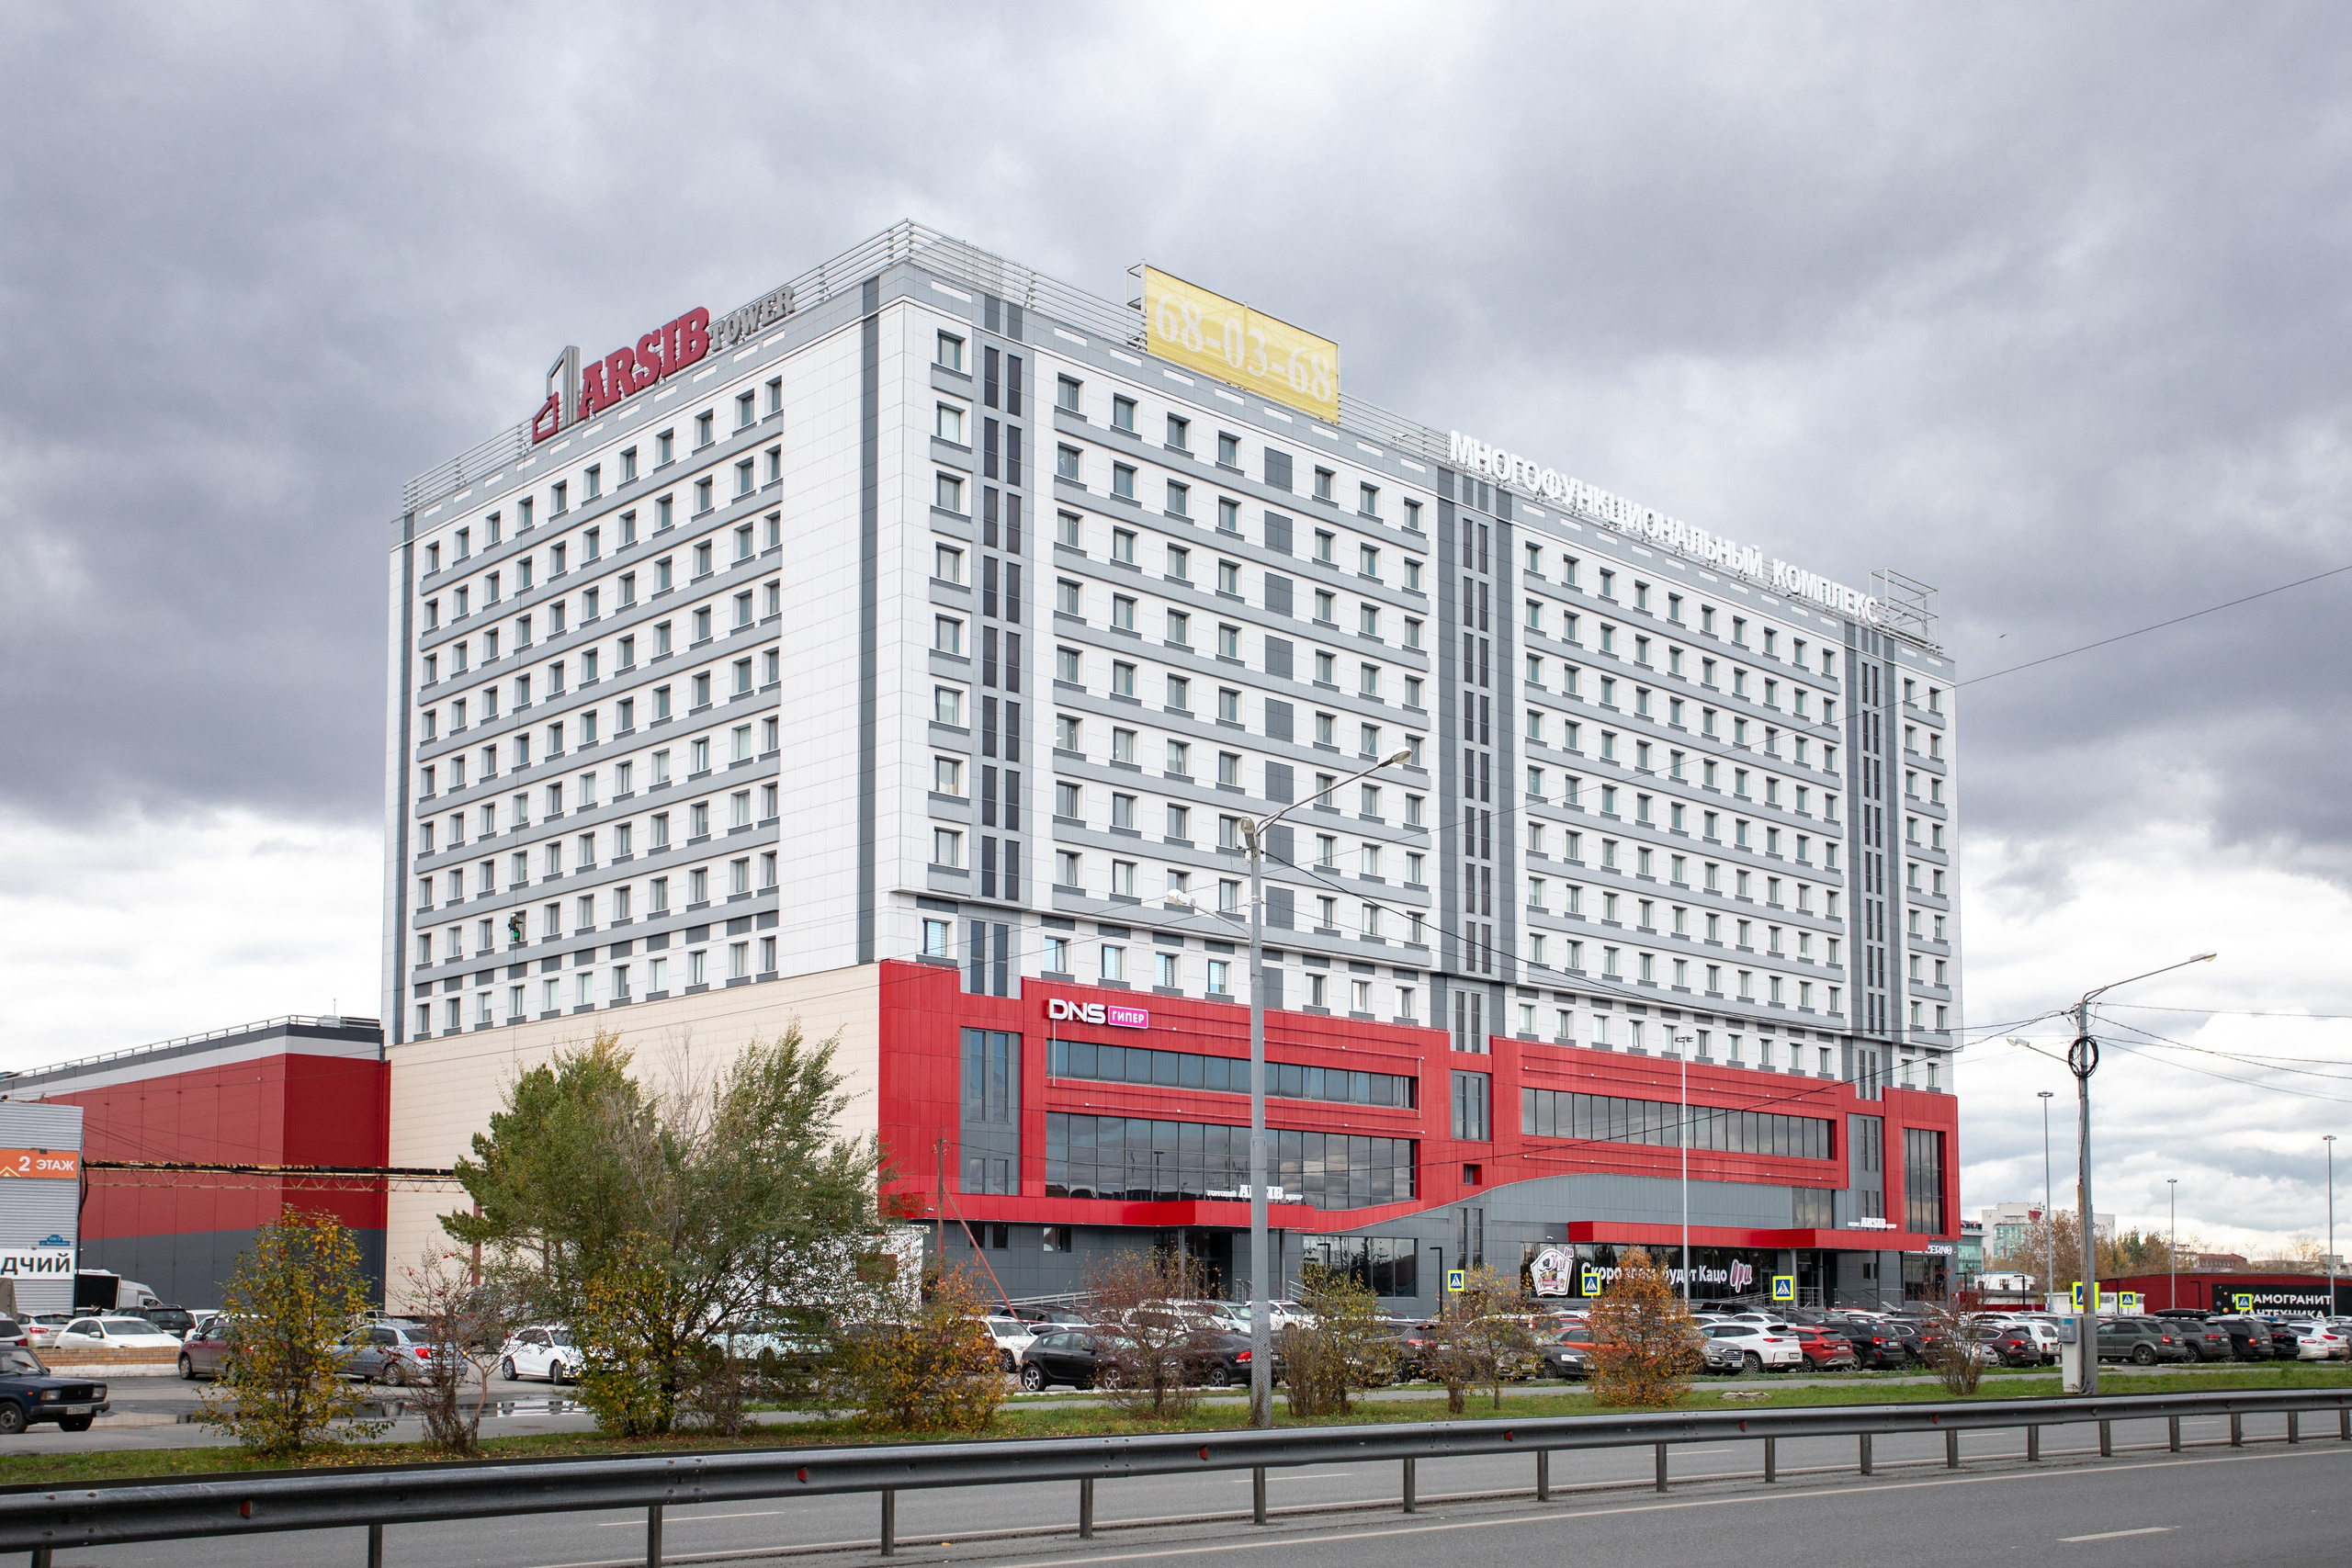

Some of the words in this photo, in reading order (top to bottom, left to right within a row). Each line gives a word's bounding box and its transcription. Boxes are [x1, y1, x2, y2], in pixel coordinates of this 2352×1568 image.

[578, 307, 710, 420] ARSIB
[708, 286, 796, 352] TOWER
[1155, 294, 1331, 402] 68-03-68
[1450, 430, 1763, 579] МНОГОФУНКЦИОНАЛЬНЫЙ
[1772, 558, 1880, 624] КОМПЛЕКС
[1048, 998, 1106, 1024] DNS
[1112, 1010, 1145, 1024] ГИПЕР
[18, 1156, 30, 1171] 2
[36, 1159, 74, 1171] ЭТАЖ
[1699, 1265, 1727, 1283] Кацо
